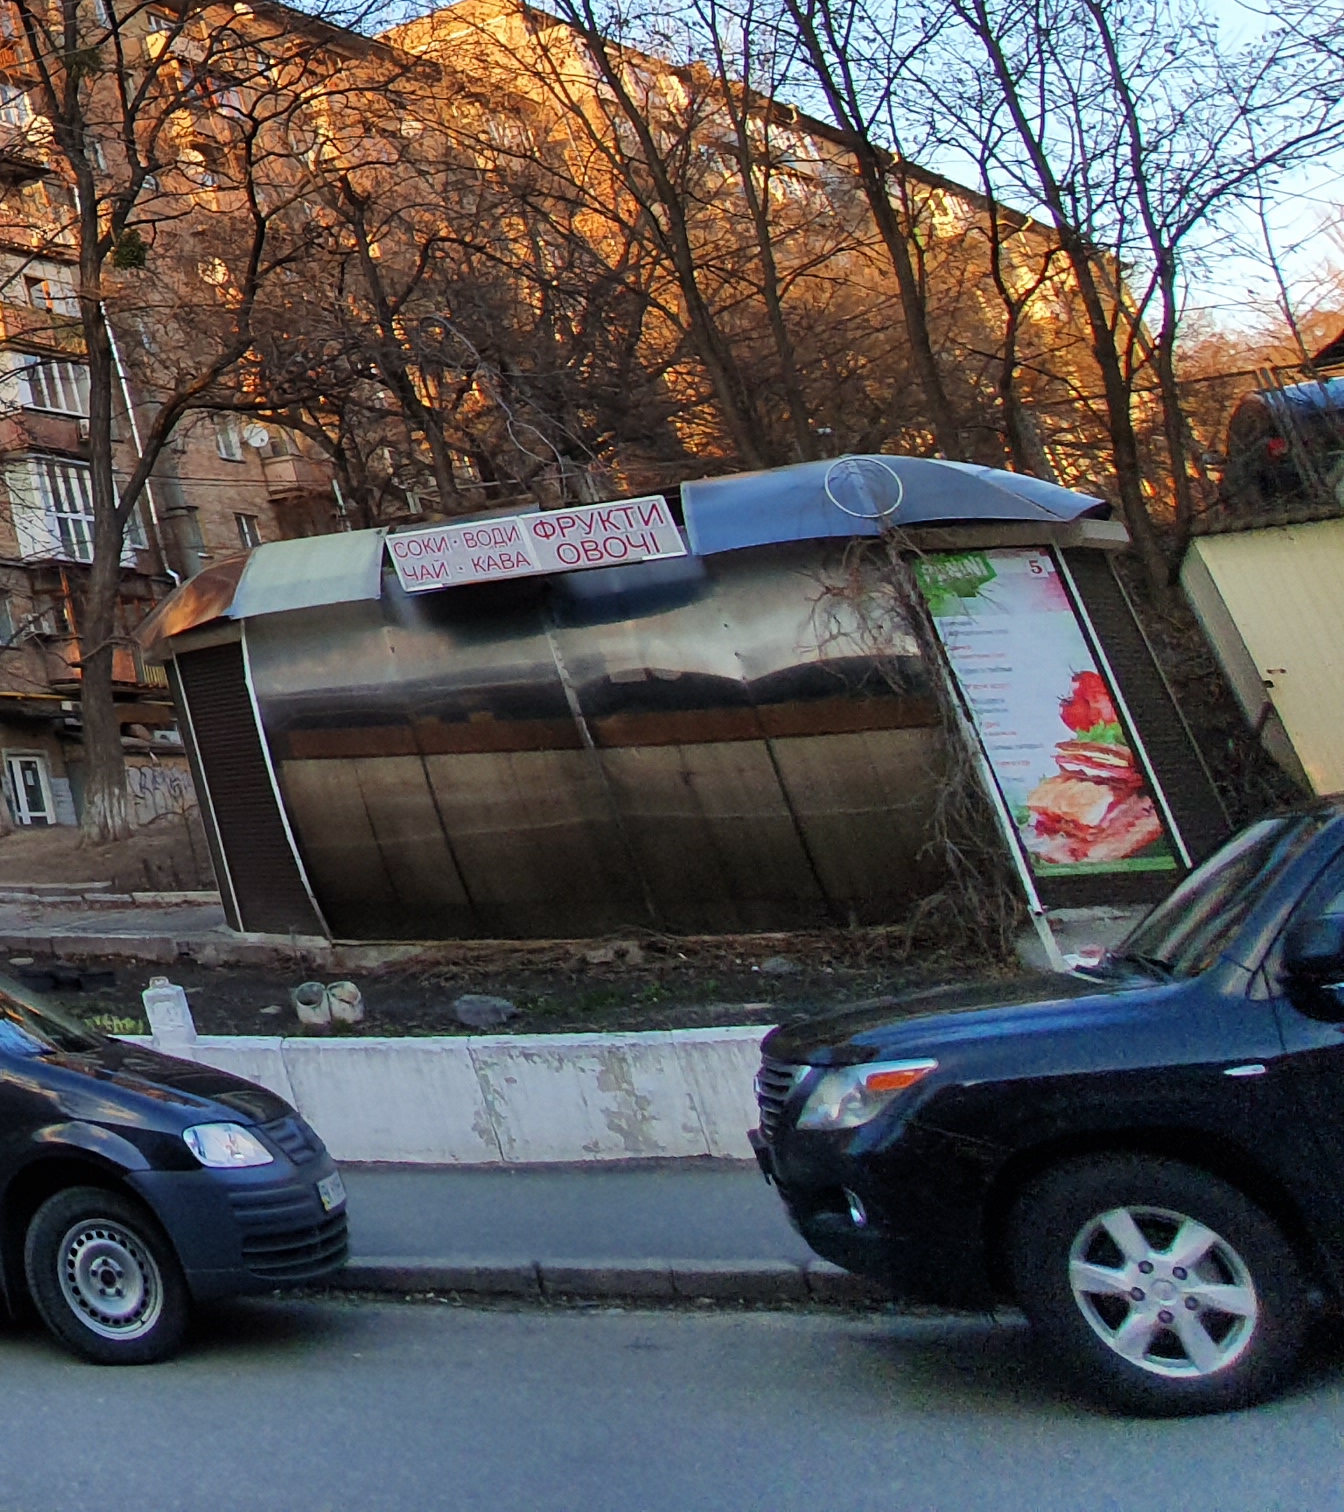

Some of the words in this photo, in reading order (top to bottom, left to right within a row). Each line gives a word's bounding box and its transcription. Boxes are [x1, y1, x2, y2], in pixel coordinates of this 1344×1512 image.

[532, 502, 664, 540] ФРУКТИ
[393, 538, 450, 559] СОКИ
[463, 525, 520, 549] ВОДИ
[556, 531, 661, 565] ОВОЧІ
[402, 561, 450, 582] ЧАЙ
[471, 550, 531, 573] КАВА
[1028, 559, 1043, 575] 5
